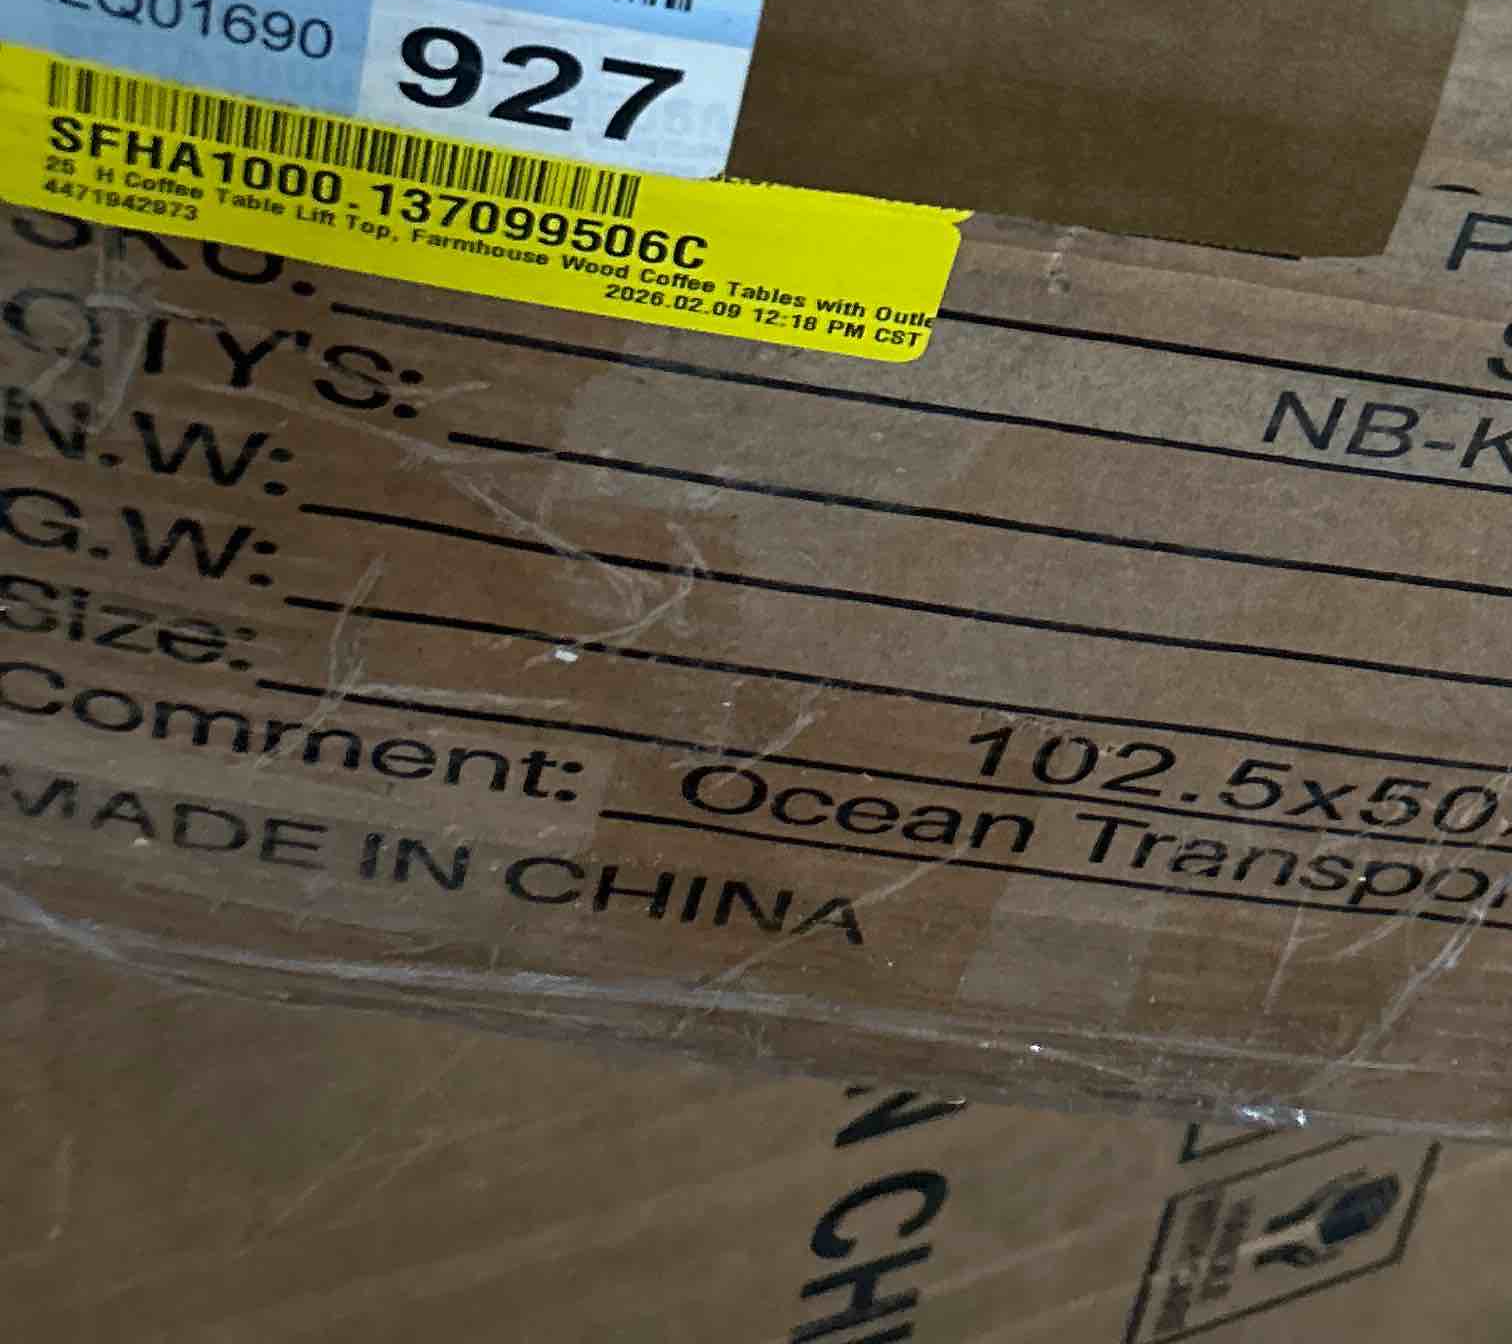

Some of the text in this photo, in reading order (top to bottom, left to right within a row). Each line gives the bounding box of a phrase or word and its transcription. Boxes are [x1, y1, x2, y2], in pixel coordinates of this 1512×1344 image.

[396, 24, 685, 143] 927
[49, 116, 709, 270] SFHA1000.137099506C
[123, 170, 204, 200] Coffee
[215, 187, 287, 216] Table
[295, 204, 336, 228] Lift
[410, 228, 550, 266] Farmhouse
[560, 254, 630, 280] Wood
[640, 266, 716, 294] Coffee
[727, 280, 807, 309] Tables
[816, 296, 866, 319] with
[603, 282, 924, 347] 2026.02.09 12:18 PM CST
[2, 384, 294, 497] N.W:
[0, 486, 279, 587] G.W:
[0, 573, 258, 672] Size:
[0, 660, 584, 803] Comment:
[680, 764, 1036, 854] Ocean
[359, 830, 472, 892] IN
[503, 855, 864, 946] CHINA
